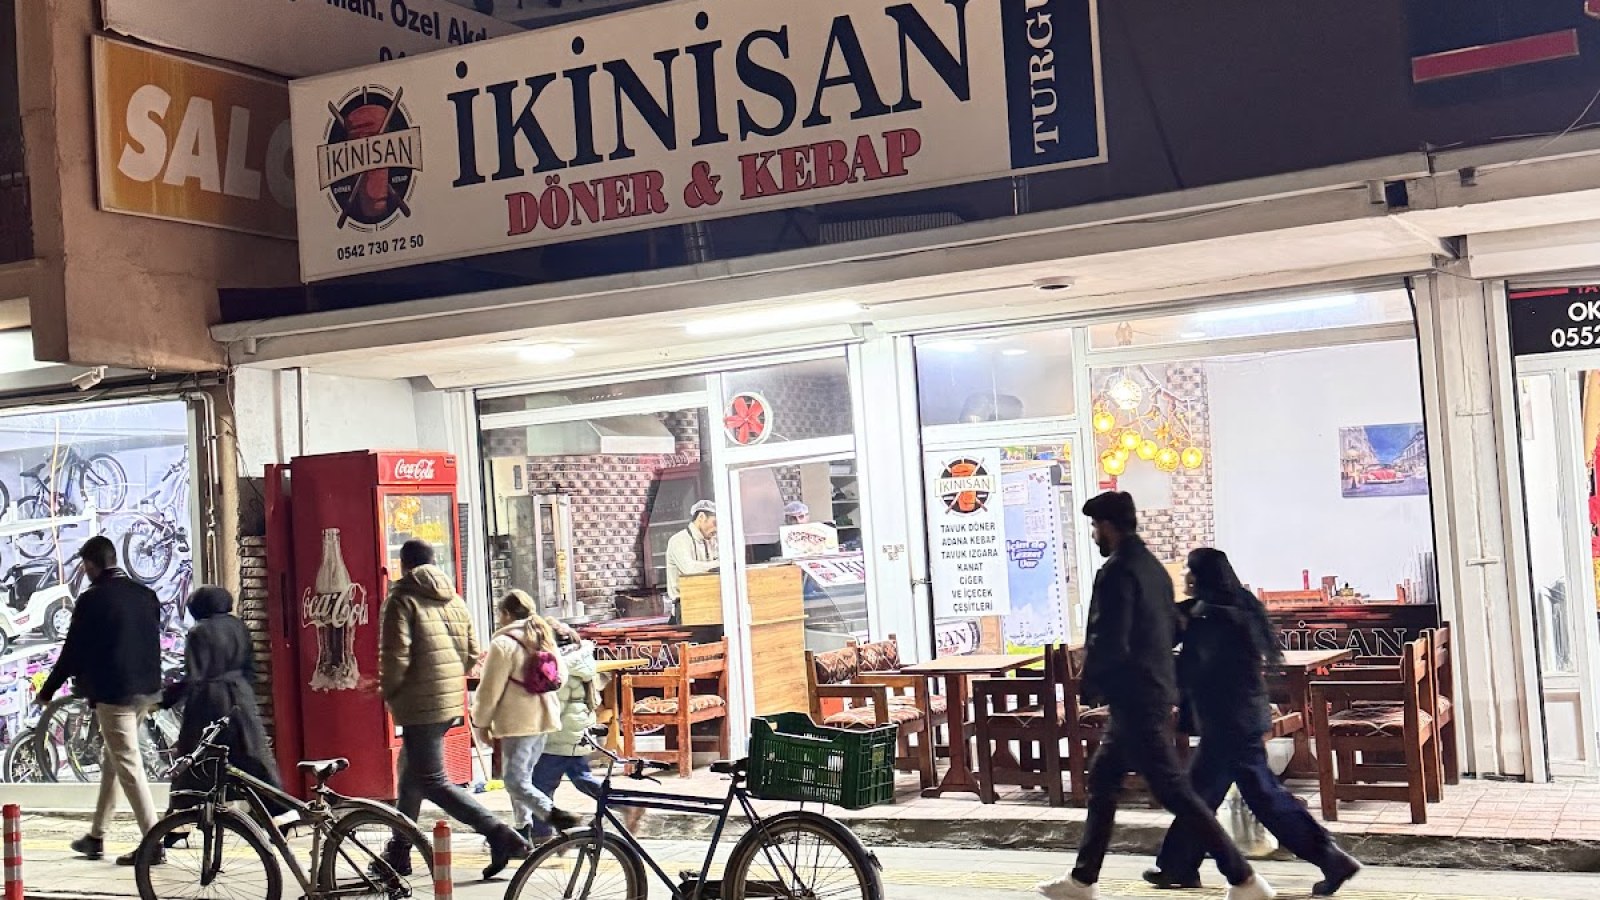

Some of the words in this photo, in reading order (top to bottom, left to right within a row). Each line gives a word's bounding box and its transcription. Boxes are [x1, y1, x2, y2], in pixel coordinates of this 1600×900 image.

[447, 0, 971, 187] İKİNİSAN
[325, 135, 413, 180] İKİNİSAN
[505, 173, 669, 237] DÖNER
[683, 160, 723, 208] &
[738, 127, 921, 200] KEBAP
[337, 244, 365, 261] 0542
[368, 241, 389, 256] 730
[392, 237, 406, 252] 72
[410, 234, 424, 249] 50
[940, 524, 966, 533] TAVUK
[968, 521, 996, 532] DÖNER
[942, 537, 968, 546] ADANA
[970, 535, 996, 545] KEBAP
[941, 550, 967, 559] TAVUK
[969, 548, 998, 558] IZGARA
[957, 562, 983, 571] KANAT
[951, 590, 963, 598] VE
[964, 587, 993, 600] İÇECEK
[953, 600, 993, 614] ÇEŞİTLERİ
